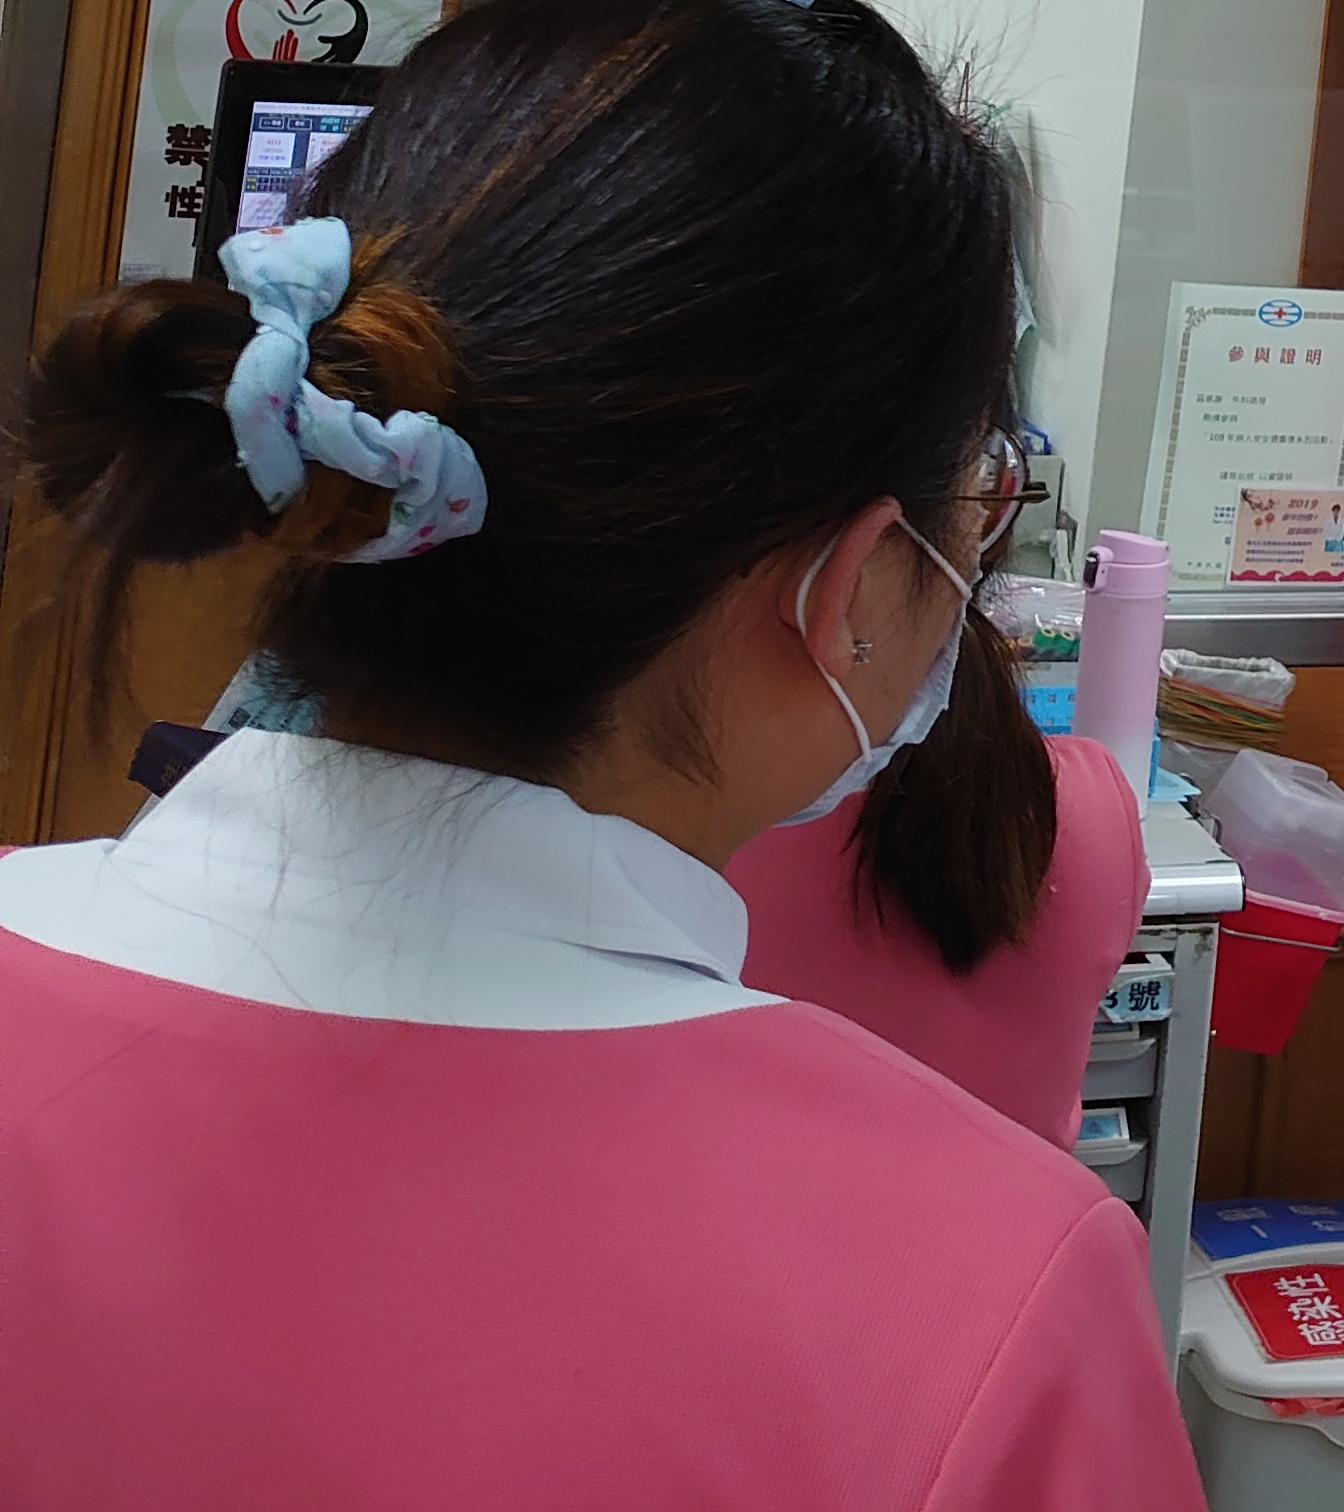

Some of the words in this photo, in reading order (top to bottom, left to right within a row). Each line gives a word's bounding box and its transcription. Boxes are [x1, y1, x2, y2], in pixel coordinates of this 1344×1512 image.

[164, 123, 213, 167] 禁
[1228, 345, 1323, 366] 參與證明
[1287, 498, 1319, 510] 2019
